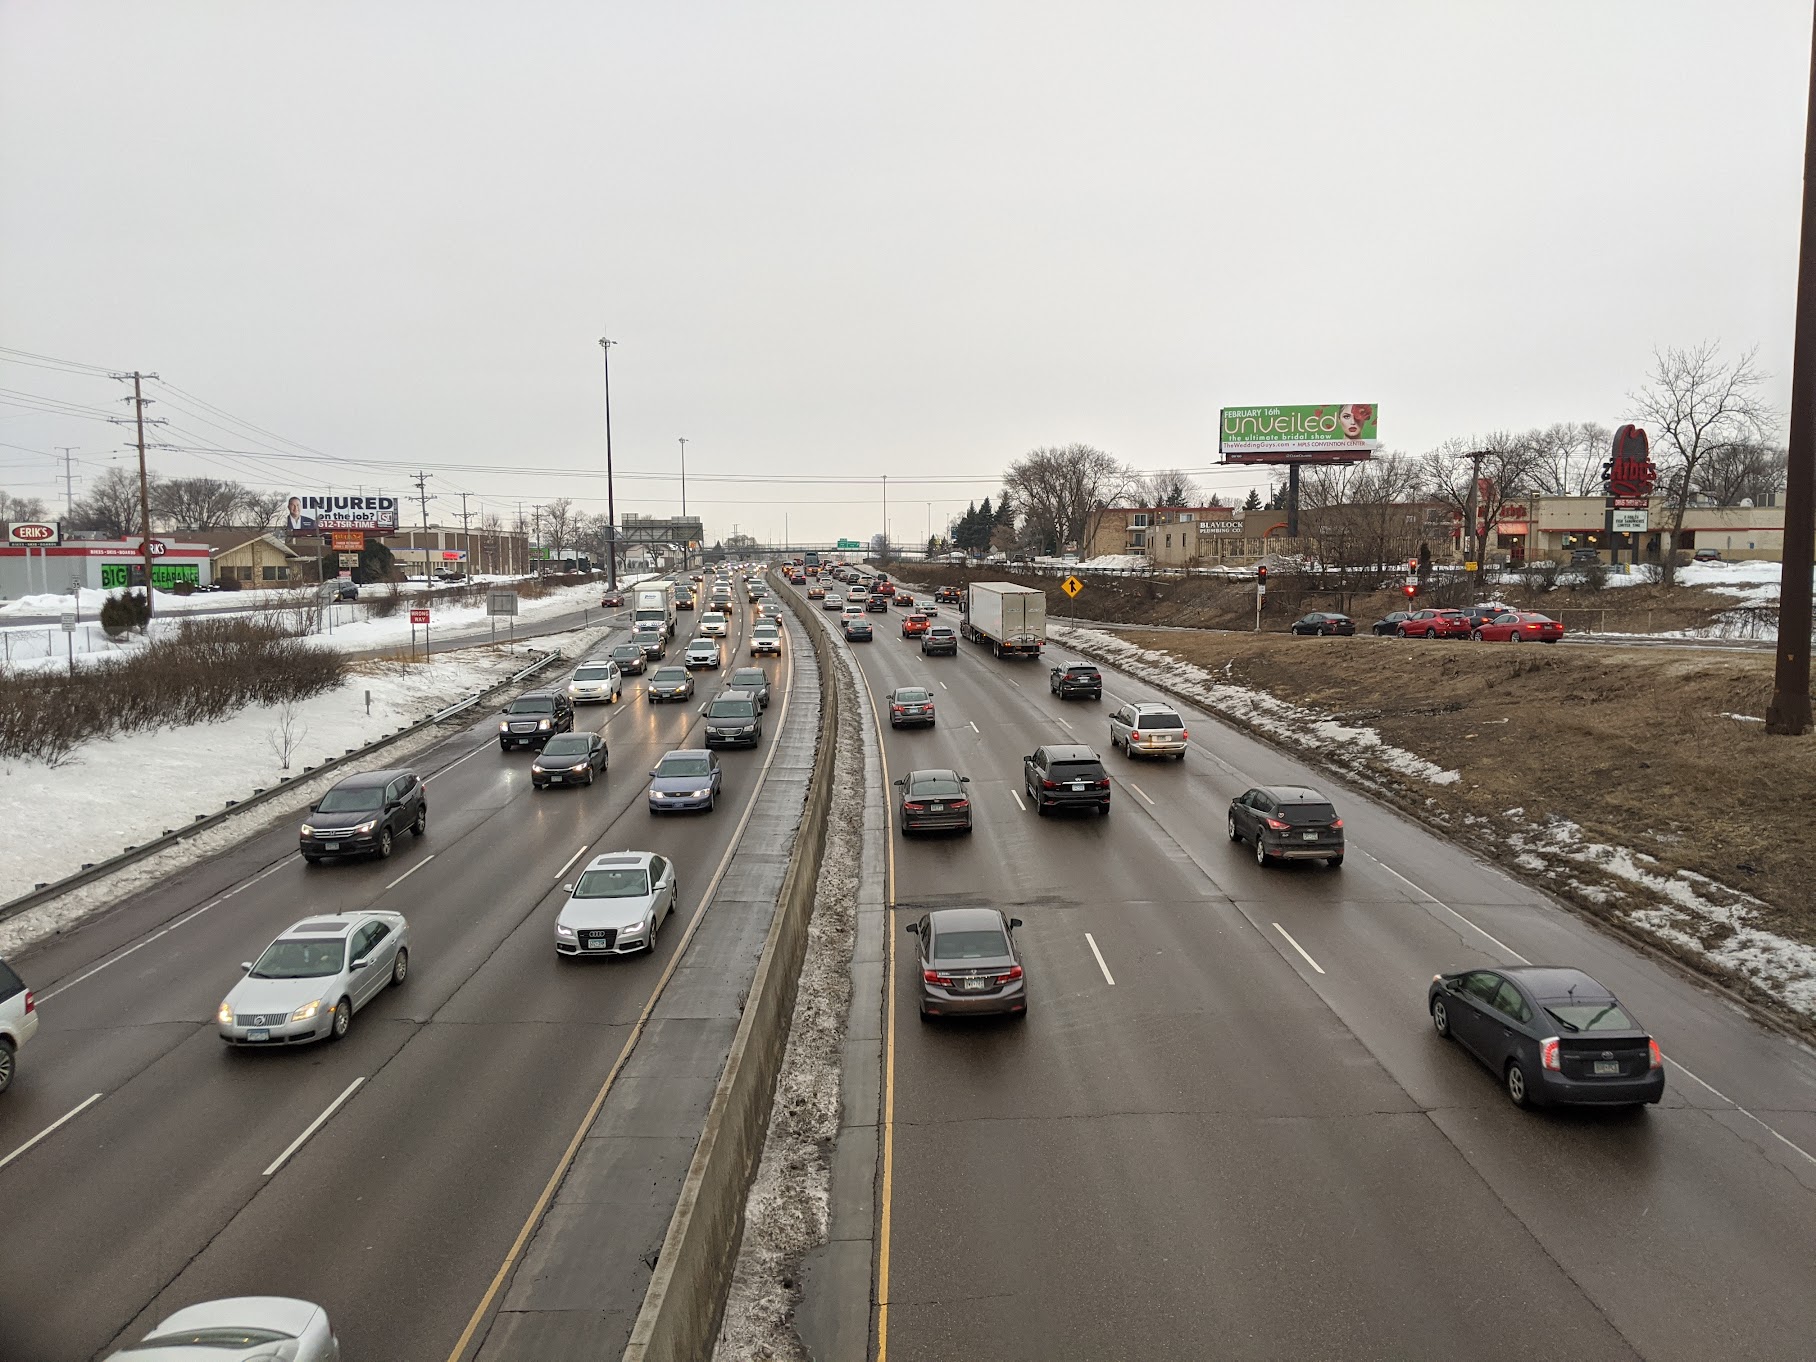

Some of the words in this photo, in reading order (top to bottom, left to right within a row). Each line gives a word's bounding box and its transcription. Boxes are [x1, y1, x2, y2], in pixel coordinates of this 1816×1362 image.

[1224, 408, 1261, 418] FEBRUARY
[1264, 408, 1280, 416] 16th
[302, 496, 393, 513] INJURED
[333, 512, 351, 520] the
[353, 512, 375, 521] job?
[20, 527, 48, 538] ERIK'S
[101, 568, 128, 586] BIG
[152, 570, 199, 583] CLEARANCE
